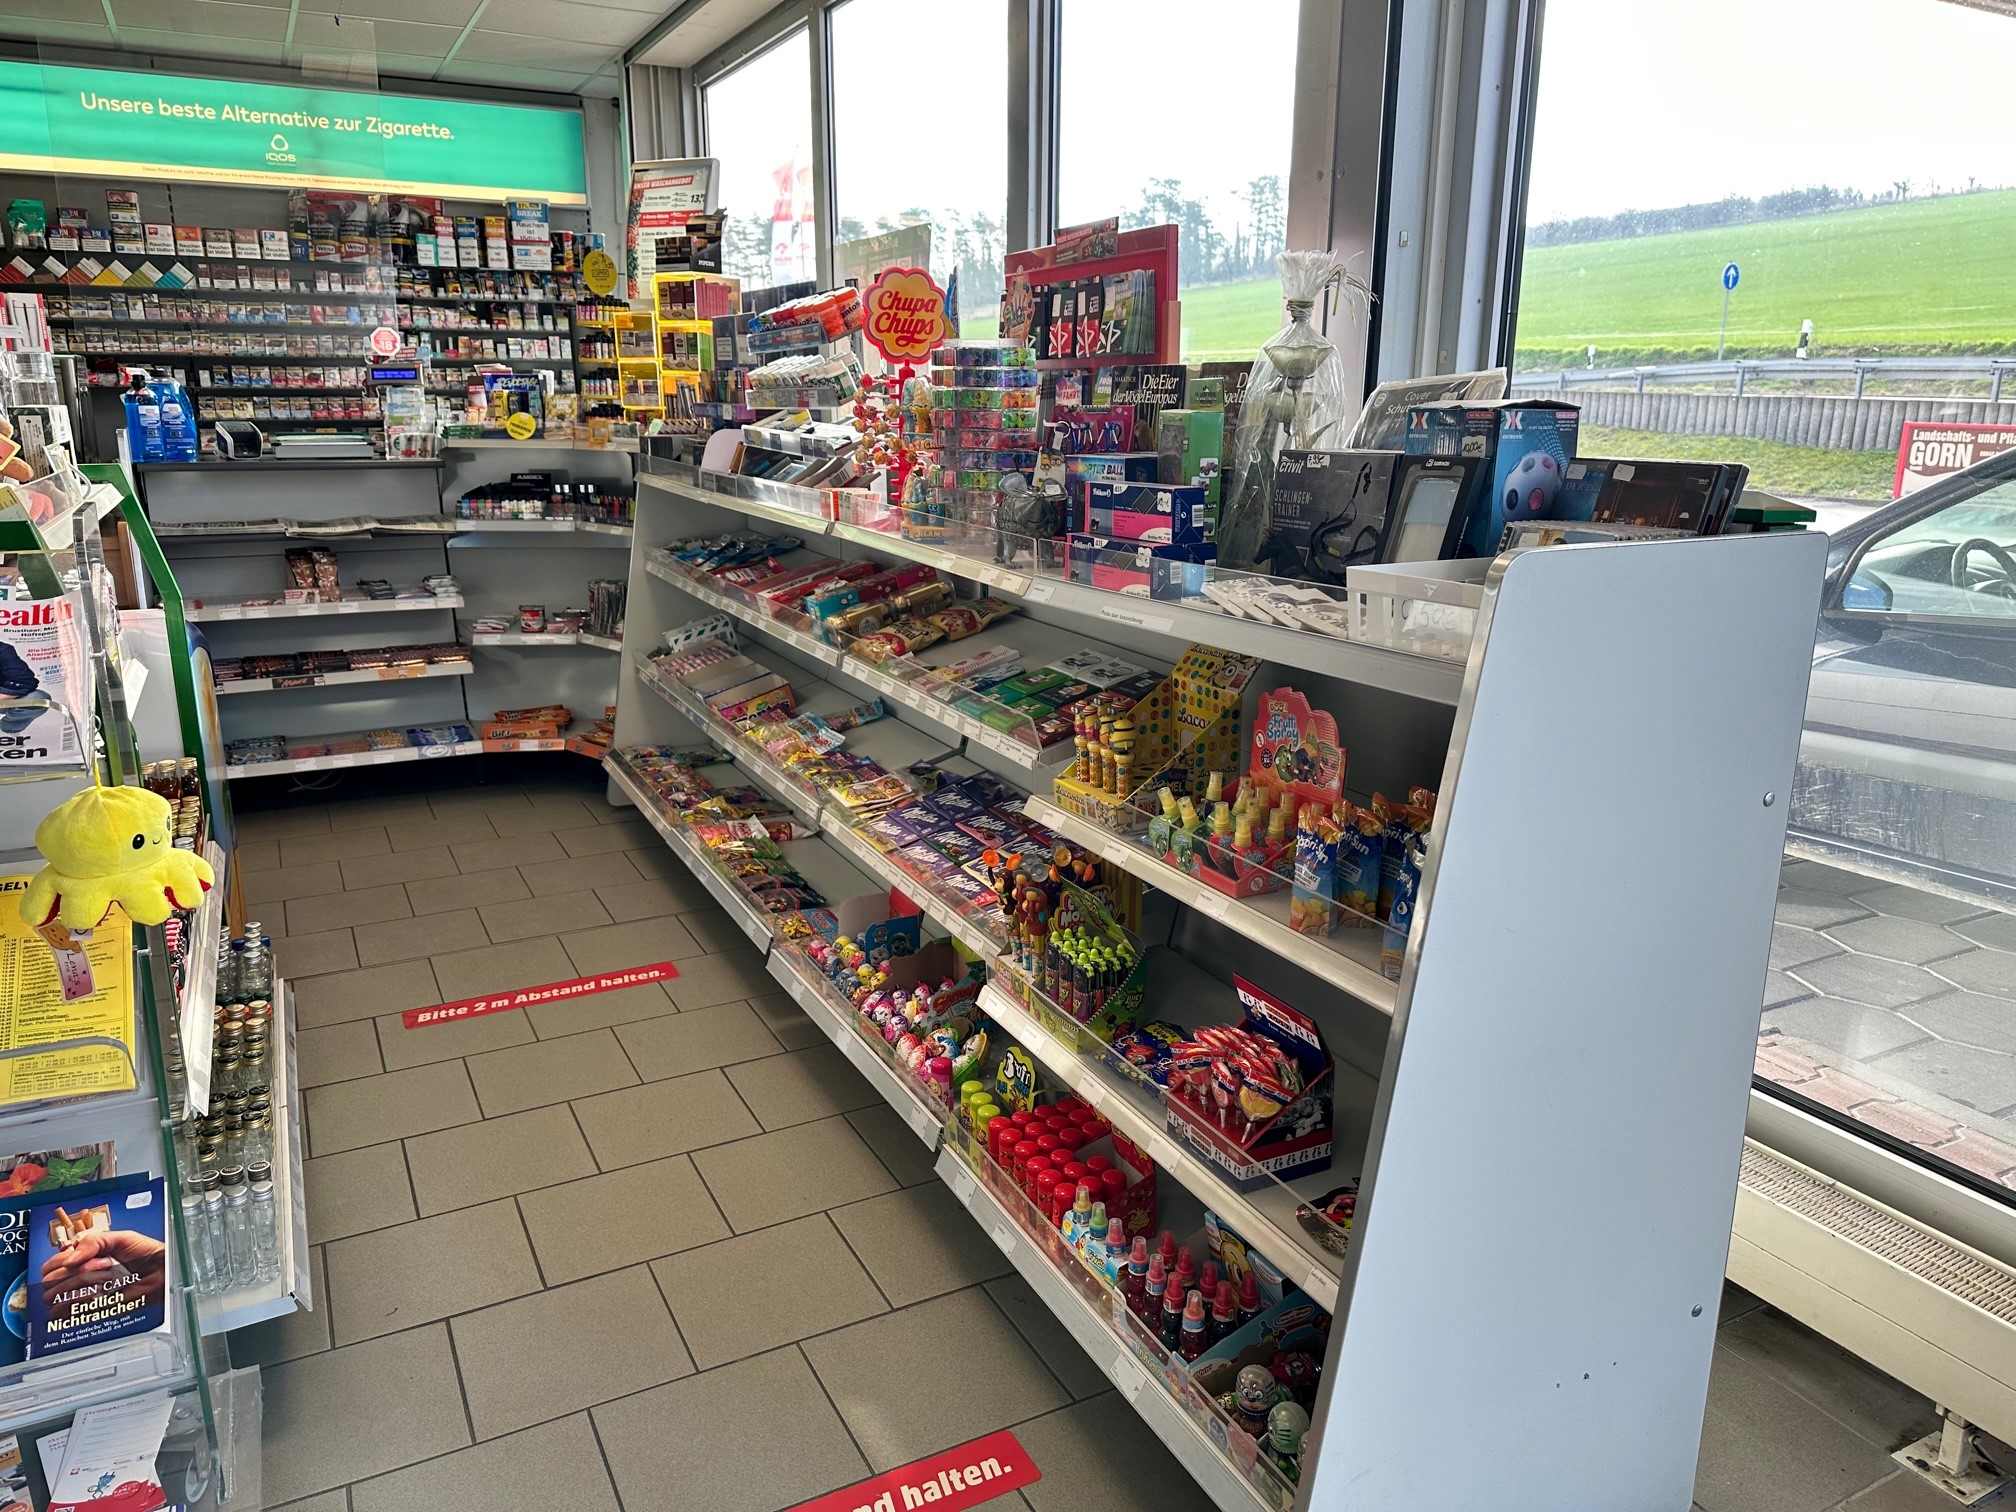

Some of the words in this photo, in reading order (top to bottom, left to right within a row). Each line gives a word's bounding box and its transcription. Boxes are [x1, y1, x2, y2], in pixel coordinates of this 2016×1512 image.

[80, 91, 154, 115] Unsere
[158, 98, 216, 120] beste
[221, 104, 330, 129] Alternative
[334, 118, 362, 132] zur
[365, 116, 455, 140] Zigarette.
[265, 152, 297, 163] IQOS
[516, 209, 542, 217] BREAK
[878, 290, 937, 316] Chupa
[875, 312, 934, 348] Chups
[379, 340, 393, 350] 18
[496, 377, 539, 388] REVOLTAGE
[1145, 390, 1178, 405] Europas
[1404, 391, 1431, 401] Cover
[1913, 429, 1975, 443] Landschafts-
[1977, 432, 1997, 443] und
[1909, 441, 1974, 468] GORN
[1106, 463, 1124, 475] BALL
[1279, 457, 1305, 474] crivit
[1274, 489, 1313, 504] SCHLINGEN-
[1274, 503, 1301, 518] TRAINER
[1270, 713, 1296, 731] Frutti
[1266, 722, 1299, 748] Spray
[935, 792, 973, 809] Milka
[901, 807, 938, 824] Milka
[969, 815, 1006, 832] Milka
[870, 820, 902, 839] Milka
[933, 829, 972, 847] Milka
[1340, 831, 1370, 855] pri-Sun
[903, 844, 941, 865] Milka
[943, 874, 982, 892] Milka
[416, 1005, 468, 1023] Bitte
[474, 1002, 486, 1012] 2
[490, 998, 510, 1008] m
[514, 981, 595, 1004] Abstand
[601, 968, 666, 988] halten.
[53, 1284, 98, 1304] ALLEN
[103, 1273, 141, 1291] CARR
[70, 1291, 124, 1315] Endlich
[47, 1295, 146, 1333] Nichtraucher!
[60, 1333, 89, 1345] Rauchen
[123, 1315, 146, 1327] machen
[76, 1324, 101, 1334] einfache
[103, 1320, 119, 1328] Weg,
[900, 1455, 1013, 1511] halten.
